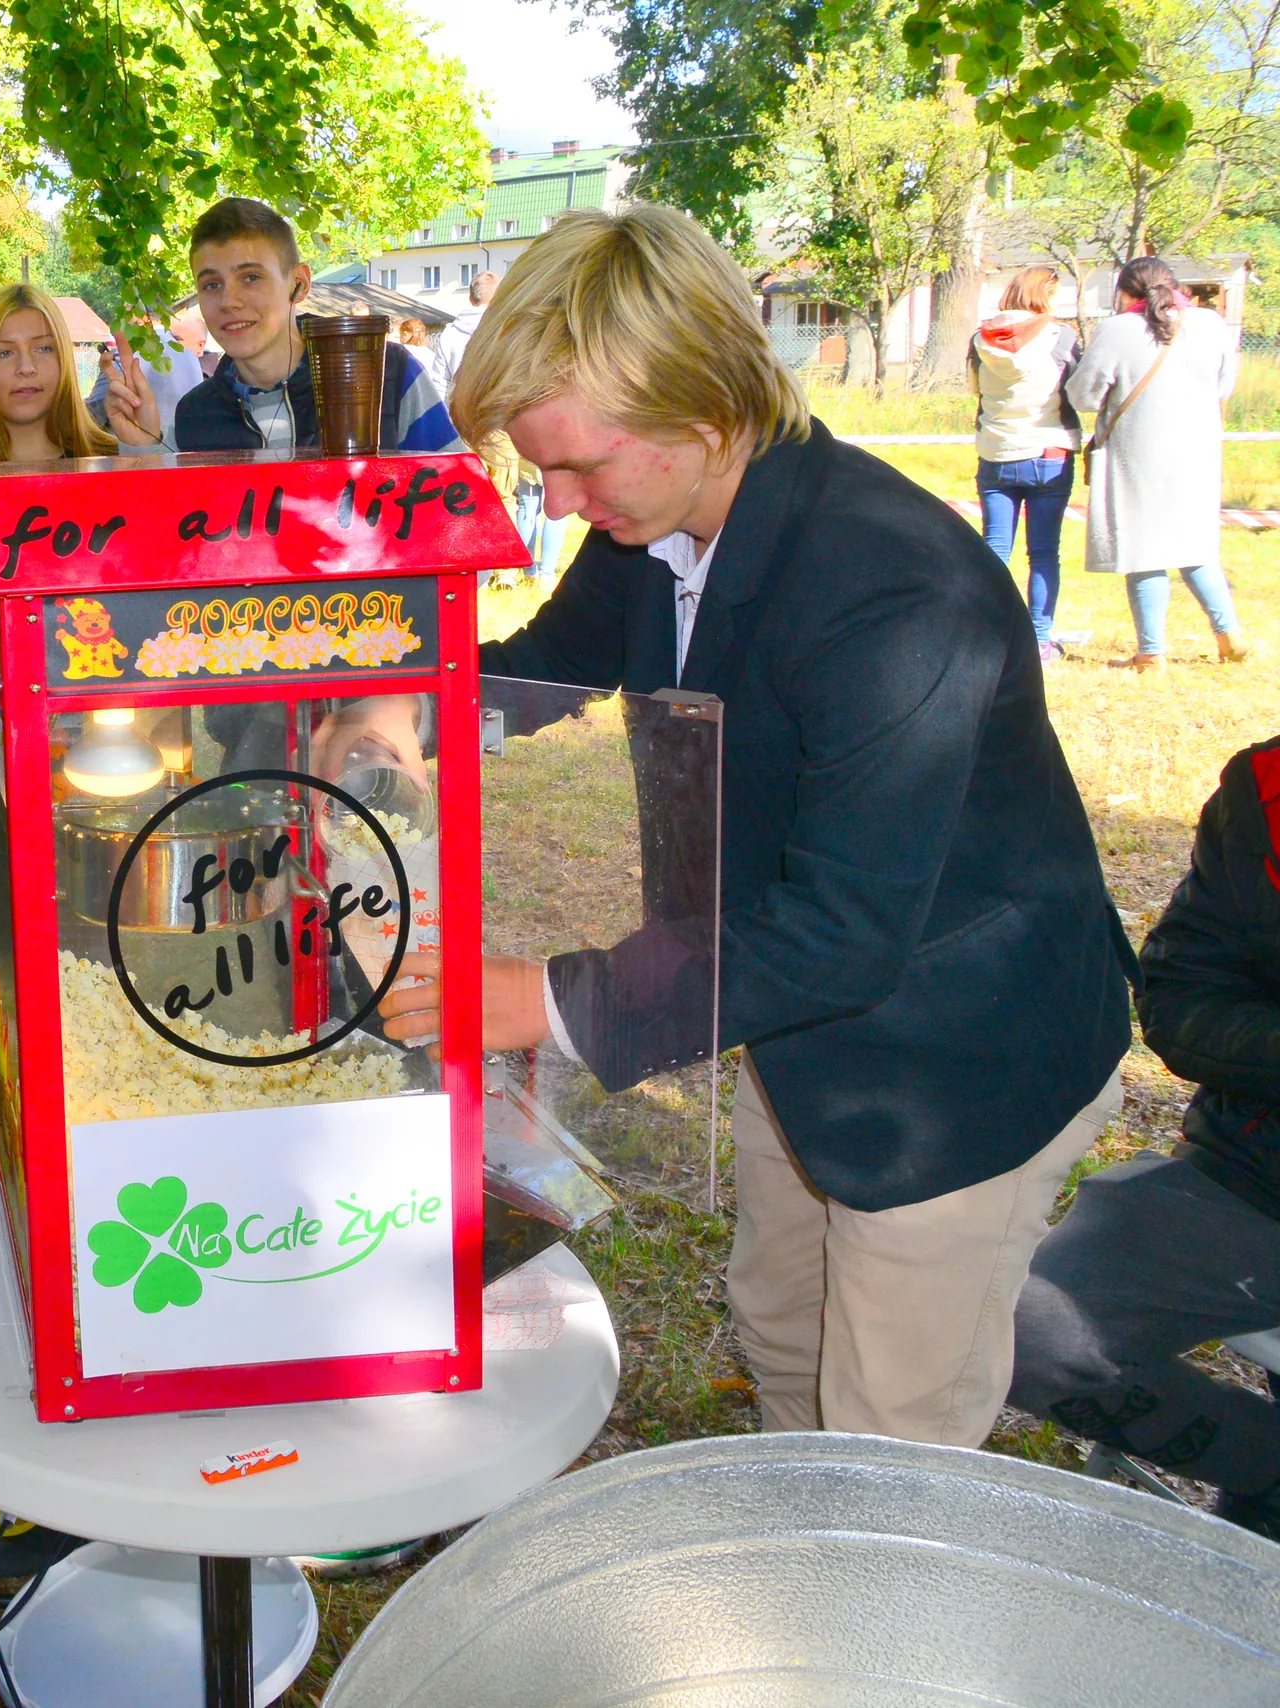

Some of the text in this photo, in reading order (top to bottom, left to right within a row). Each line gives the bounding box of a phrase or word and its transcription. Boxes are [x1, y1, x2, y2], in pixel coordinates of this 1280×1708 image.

[0, 466, 476, 580] for all life
[166, 590, 410, 641] POPCORN
[182, 834, 291, 934] for
[164, 882, 392, 1019] all life
[176, 1223, 222, 1258] Na
[335, 1189, 441, 1252] Życie
